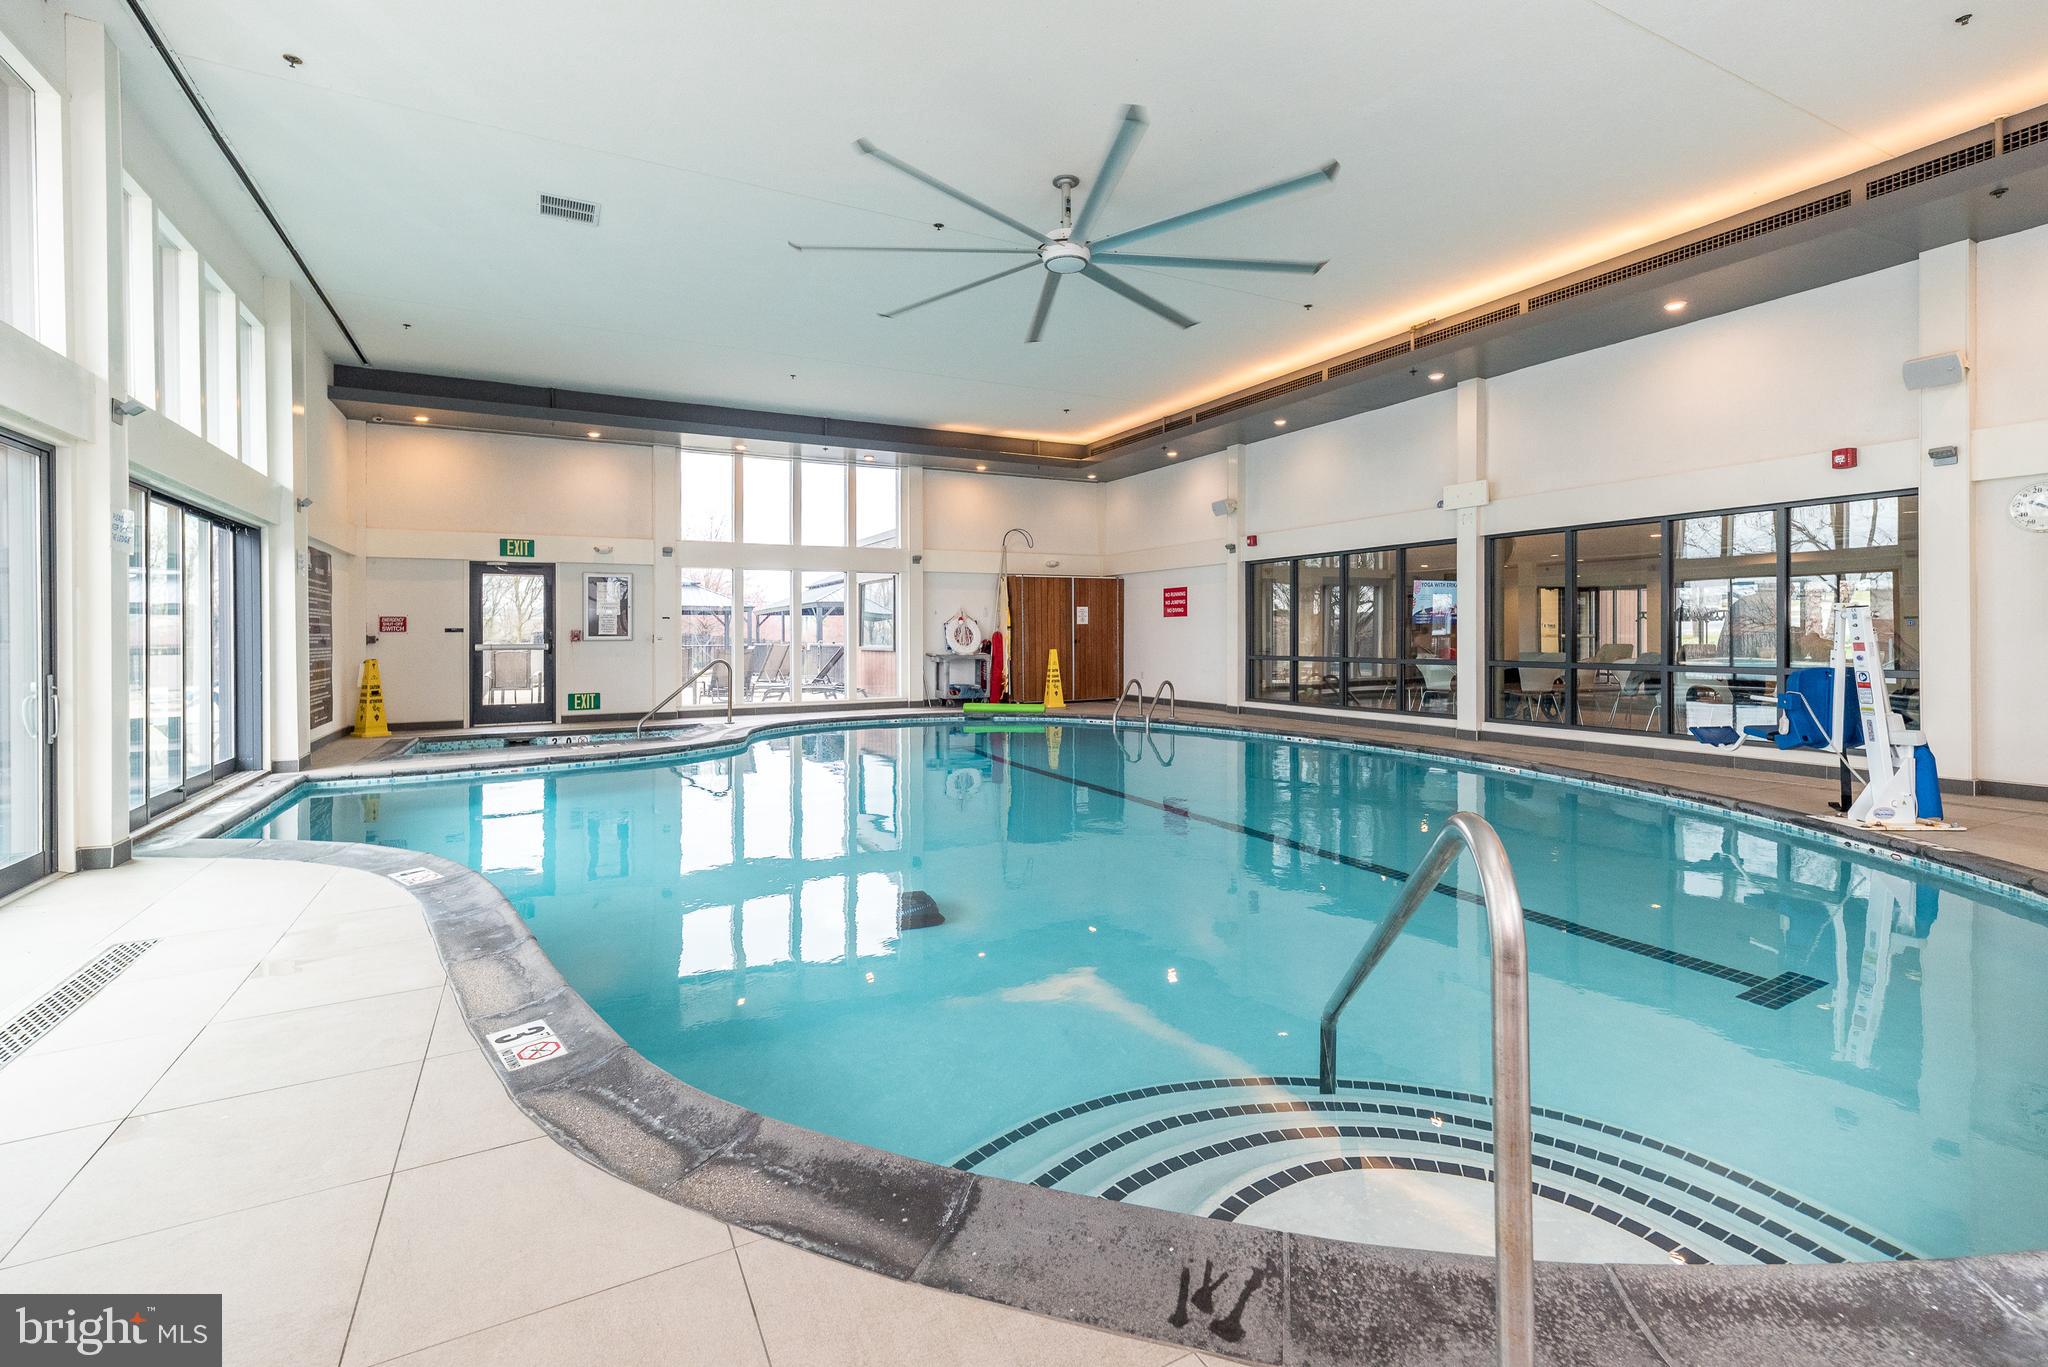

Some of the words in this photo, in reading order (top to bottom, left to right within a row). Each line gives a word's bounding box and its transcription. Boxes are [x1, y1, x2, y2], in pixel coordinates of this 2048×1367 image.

[506, 540, 530, 556] EXIT
[574, 694, 595, 709] EXIT
[494, 1026, 545, 1044] 3
